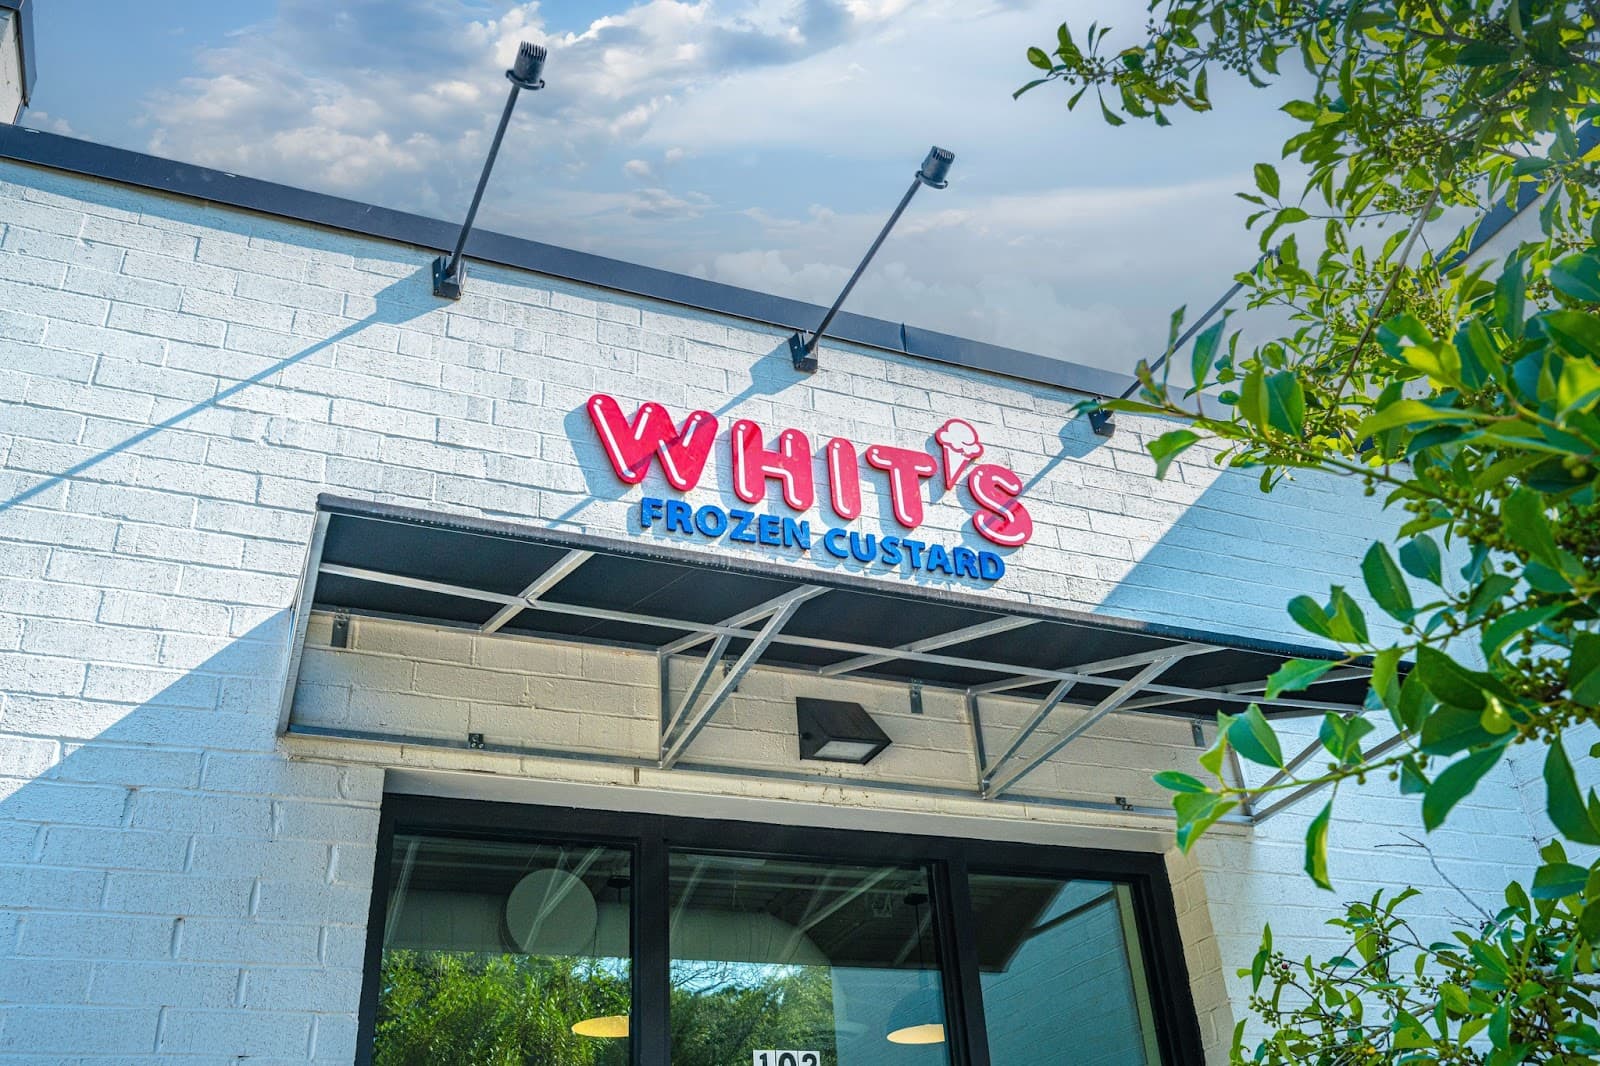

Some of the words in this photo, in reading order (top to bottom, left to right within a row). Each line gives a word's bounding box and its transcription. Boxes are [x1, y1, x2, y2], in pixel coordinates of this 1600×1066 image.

[587, 394, 1033, 547] WHIT'S
[641, 497, 810, 550] FROZEN
[824, 528, 1006, 581] CUSTARD
